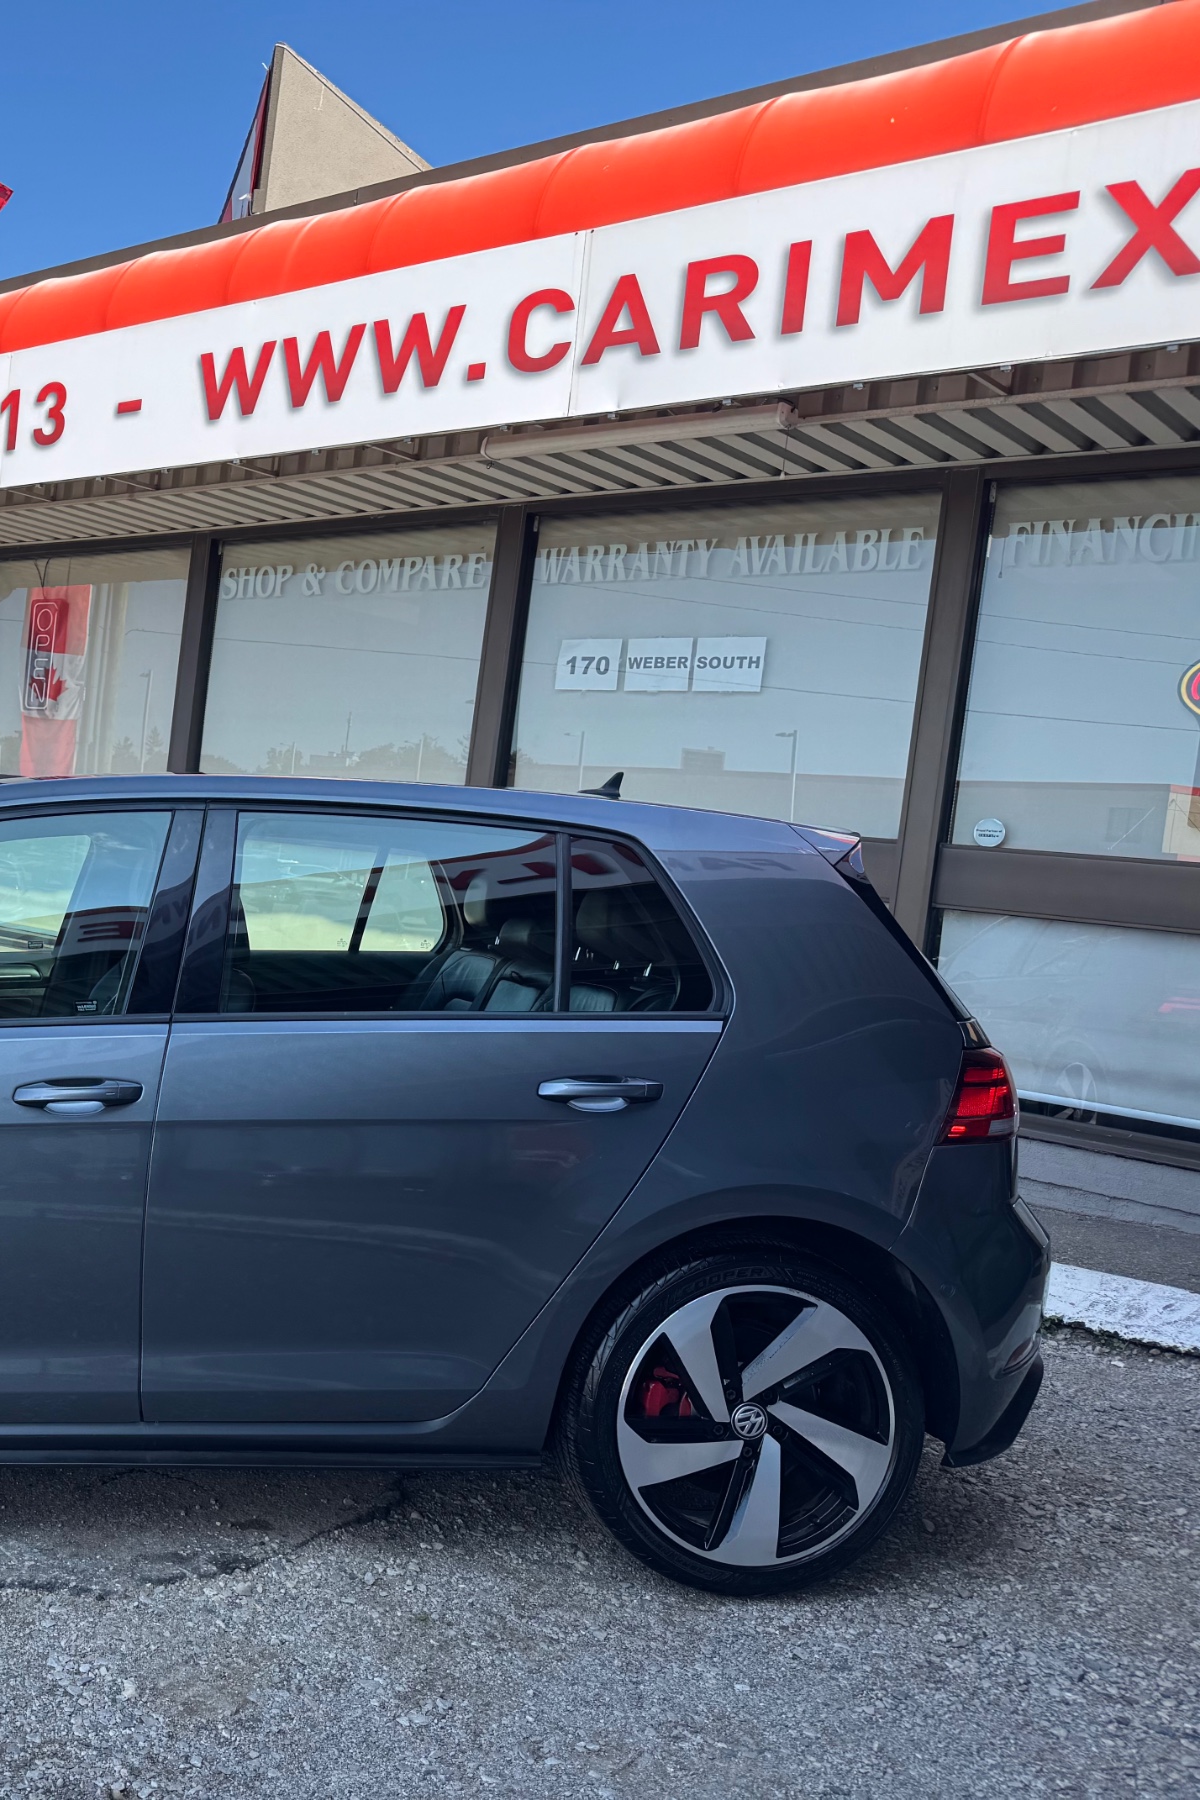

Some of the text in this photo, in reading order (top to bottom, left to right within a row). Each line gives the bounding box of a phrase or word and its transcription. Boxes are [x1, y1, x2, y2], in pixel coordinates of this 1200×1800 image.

[200, 168, 1200, 420] WWW.CARIMEX
[540, 527, 924, 584] WARRANTY AVAILABLE
[1007, 513, 1200, 567] FINANCI
[221, 552, 488, 599] SHOP & COMPARE
[565, 655, 611, 676] 170
[628, 656, 689, 670] WEBER
[696, 655, 761, 671] SOUTH
